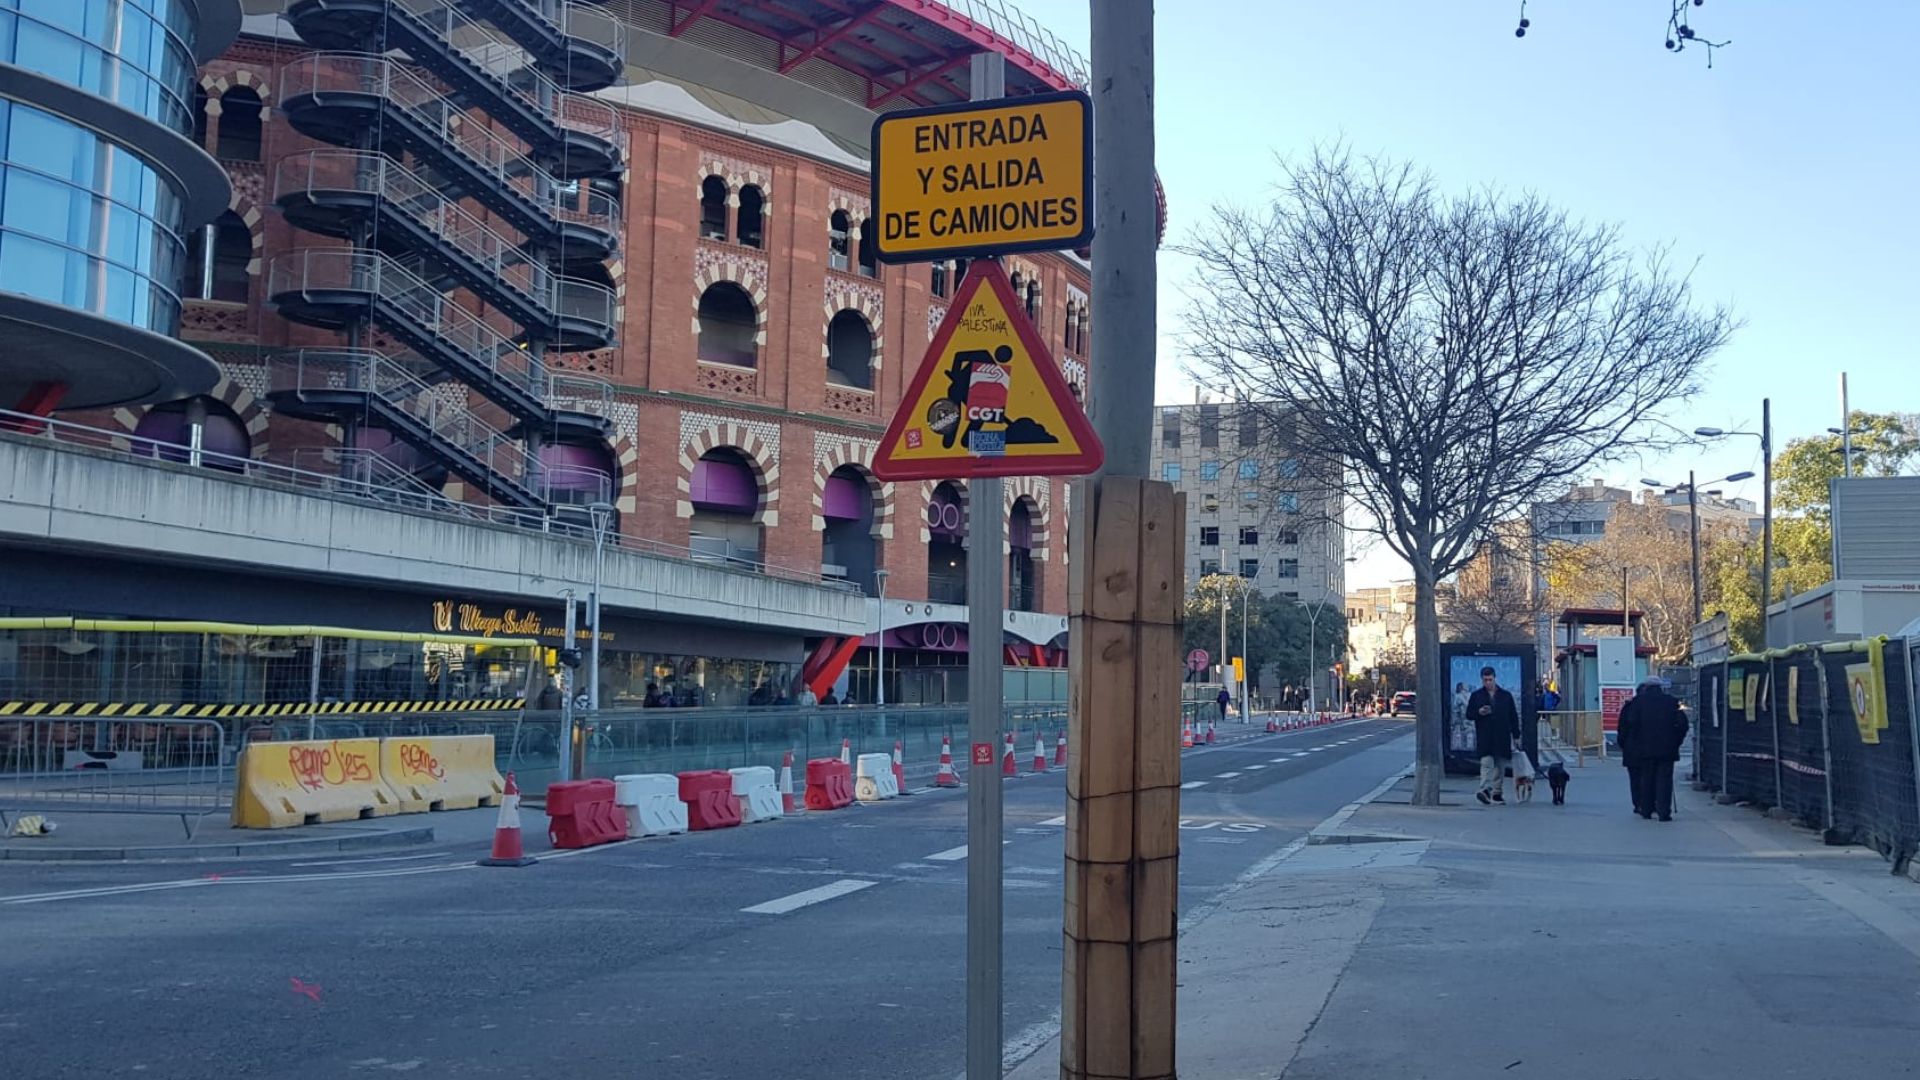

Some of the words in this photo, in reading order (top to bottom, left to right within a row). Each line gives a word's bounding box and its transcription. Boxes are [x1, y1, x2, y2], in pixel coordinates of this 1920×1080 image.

[915, 113, 1048, 154] ENTRADA
[916, 166, 935, 195] Y
[942, 157, 1045, 193] SALIDA
[885, 211, 920, 241] DE
[929, 197, 1078, 237] CAMIONES
[968, 406, 1004, 422] CGT
[1178, 819, 1267, 833] US
